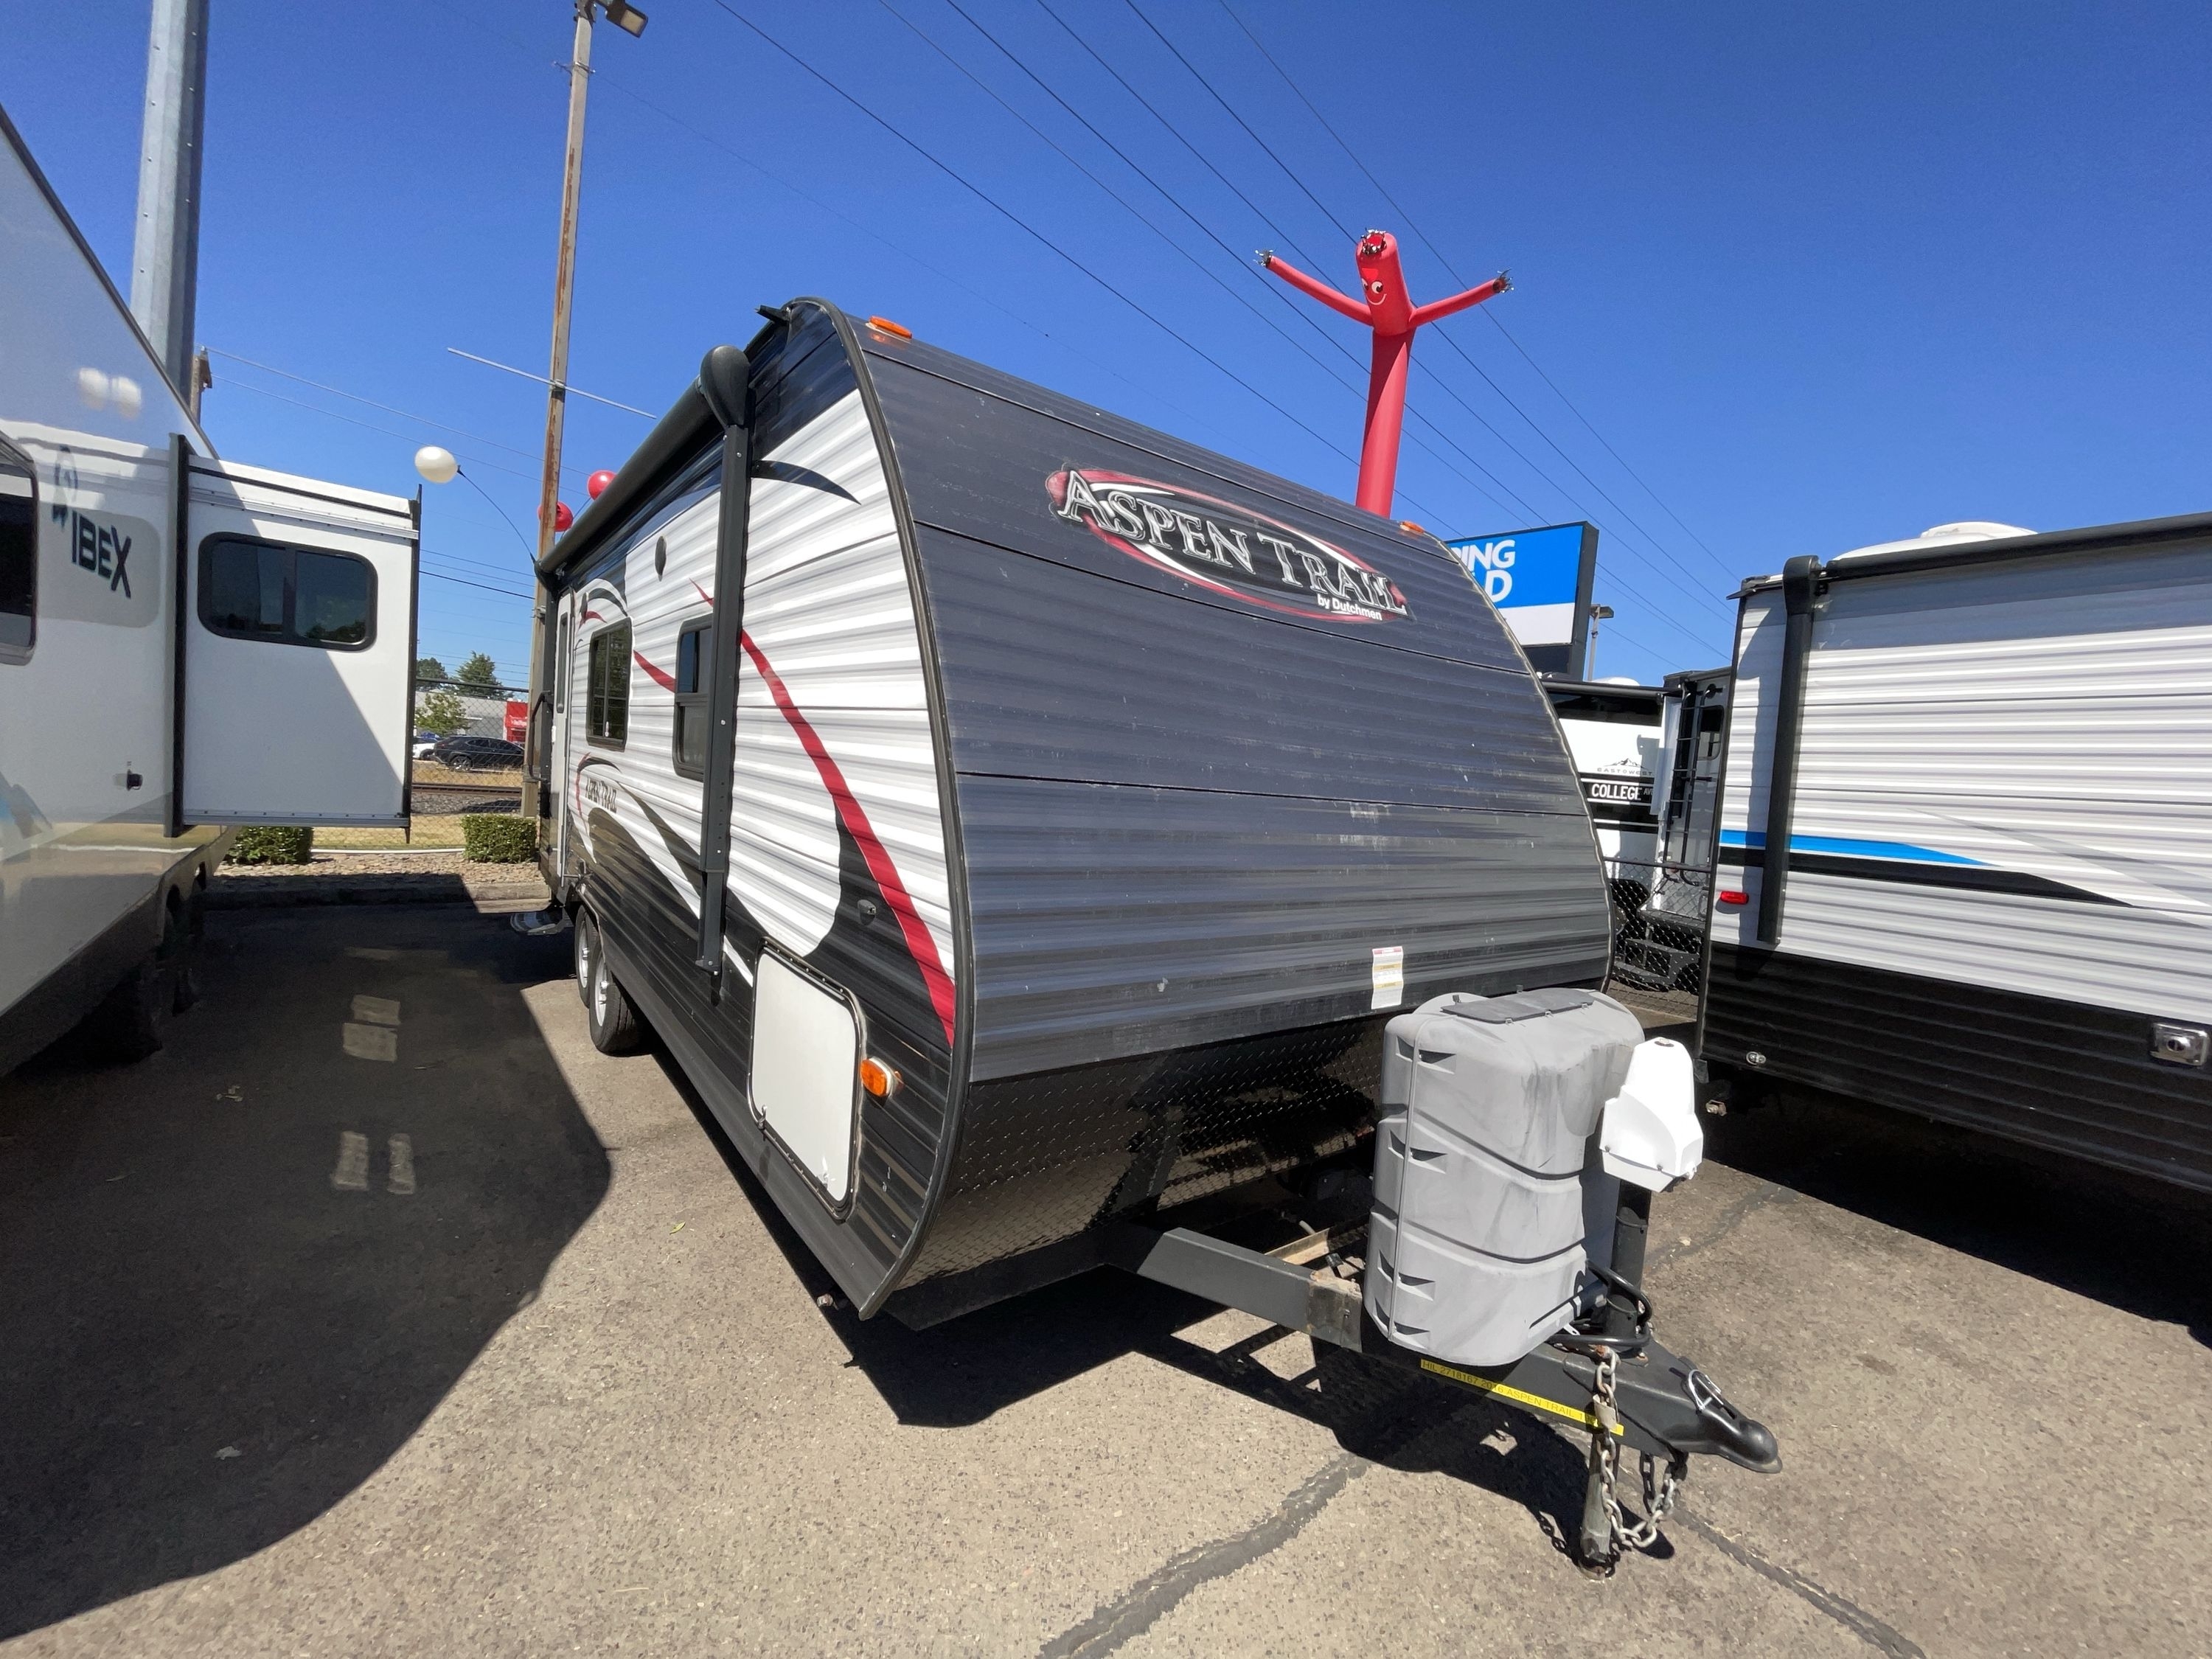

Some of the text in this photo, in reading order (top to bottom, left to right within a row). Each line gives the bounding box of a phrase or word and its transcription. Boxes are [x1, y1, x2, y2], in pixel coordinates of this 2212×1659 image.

[72, 509, 132, 599] IBEX
[1057, 470, 1408, 616] ASPEN TRAIL
[1317, 593, 1383, 621] by Dutchmen
[1591, 783, 1653, 801] COLLEGE AV
[1422, 1360, 1438, 1372] HIL
[1439, 1366, 1479, 1385] 2718167
[1481, 1379, 1504, 1394] 2016
[1506, 1387, 1543, 1406] ASPEN
[1545, 1399, 1575, 1418] TRAIL
